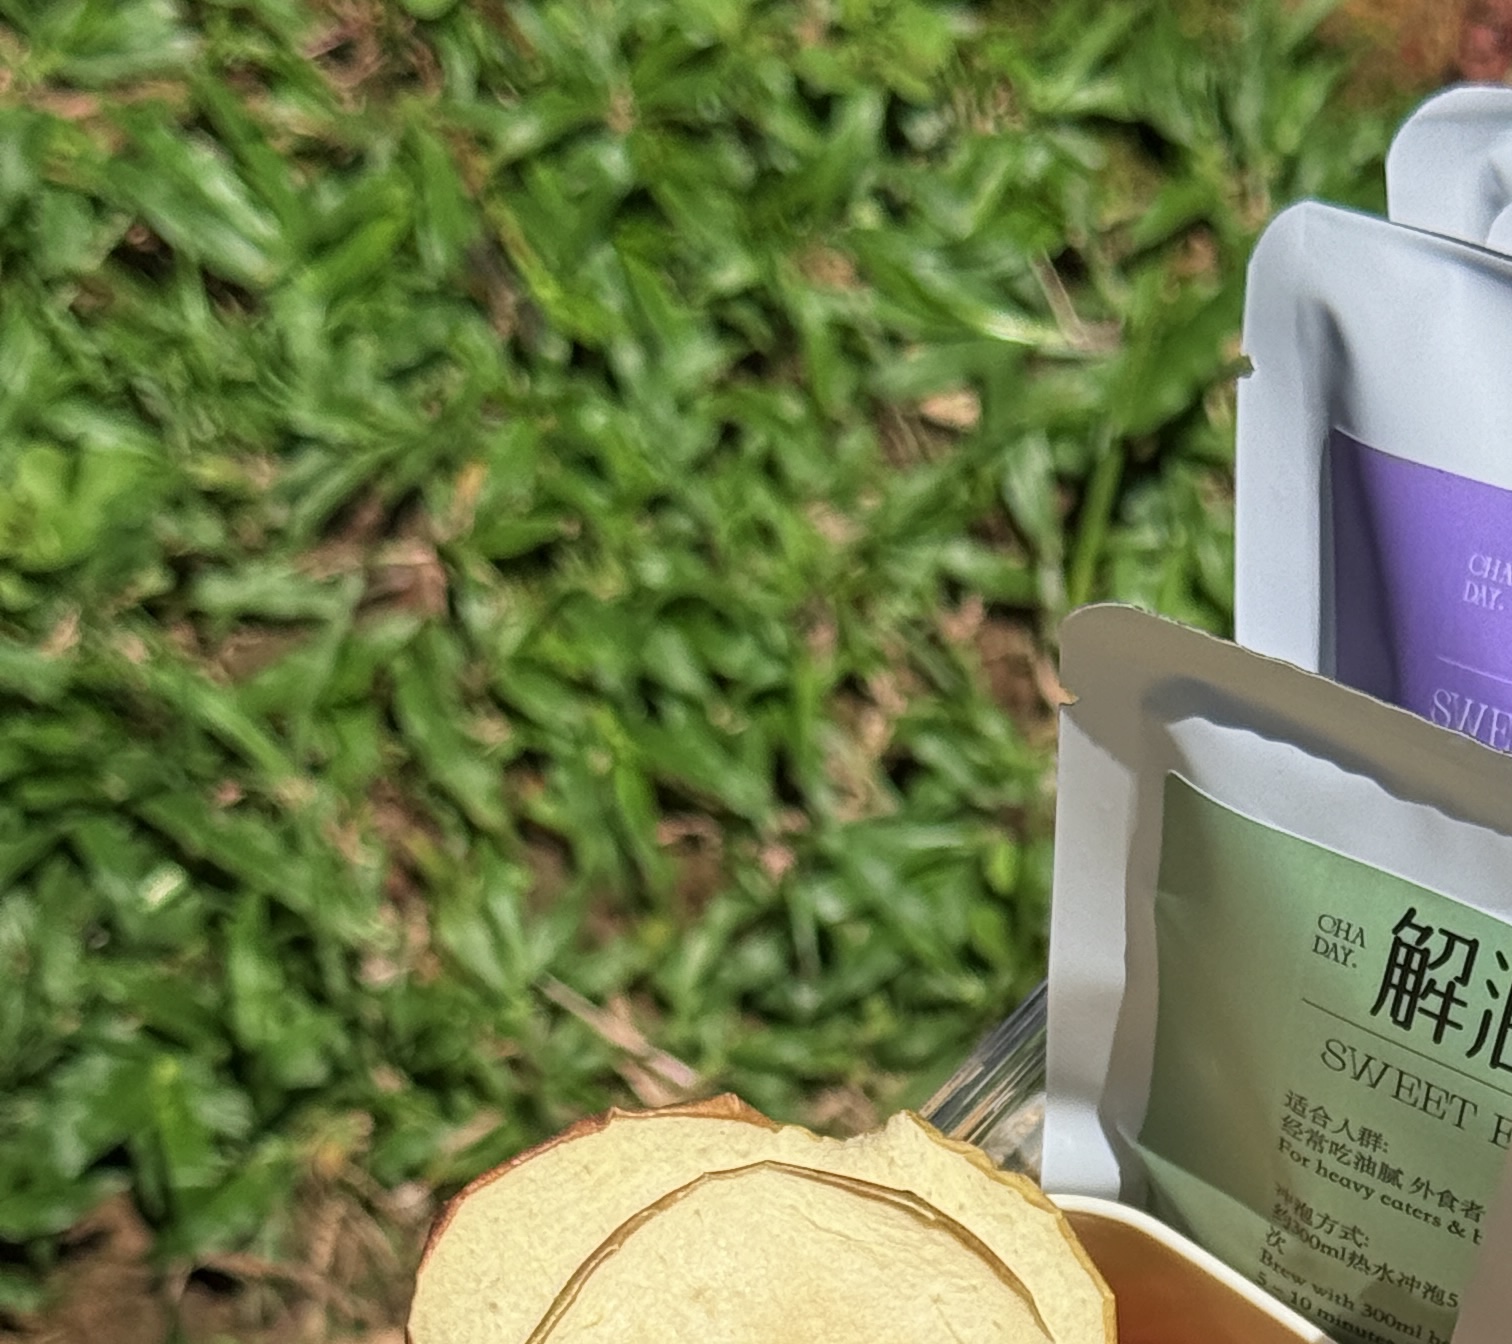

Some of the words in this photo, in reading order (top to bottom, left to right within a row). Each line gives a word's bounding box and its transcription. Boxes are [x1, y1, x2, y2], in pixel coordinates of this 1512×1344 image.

[1468, 553, 1512, 587] CHA
[1464, 580, 1504, 611] DAY.
[1318, 914, 1366, 950] CHA
[1312, 935, 1357, 969] DAY.
[1320, 1038, 1478, 1131] SWEET
[1284, 1089, 1389, 1154] 适合人群:
[1278, 1136, 1311, 1168] For
[1315, 1159, 1376, 1200] heavy
[1380, 1193, 1442, 1229] eaters
[1447, 1221, 1466, 1239] &
[1281, 1114, 1405, 1190] 经常吃油腻
[1409, 1175, 1487, 1223] 外食者
[1265, 1226, 1287, 1256] 次
[1255, 1272, 1267, 1287] 5
[1290, 1291, 1312, 1311] 10
[1259, 1249, 1306, 1287] Brew
[1312, 1282, 1355, 1312] with
[1360, 1302, 1422, 1340] 300ml
